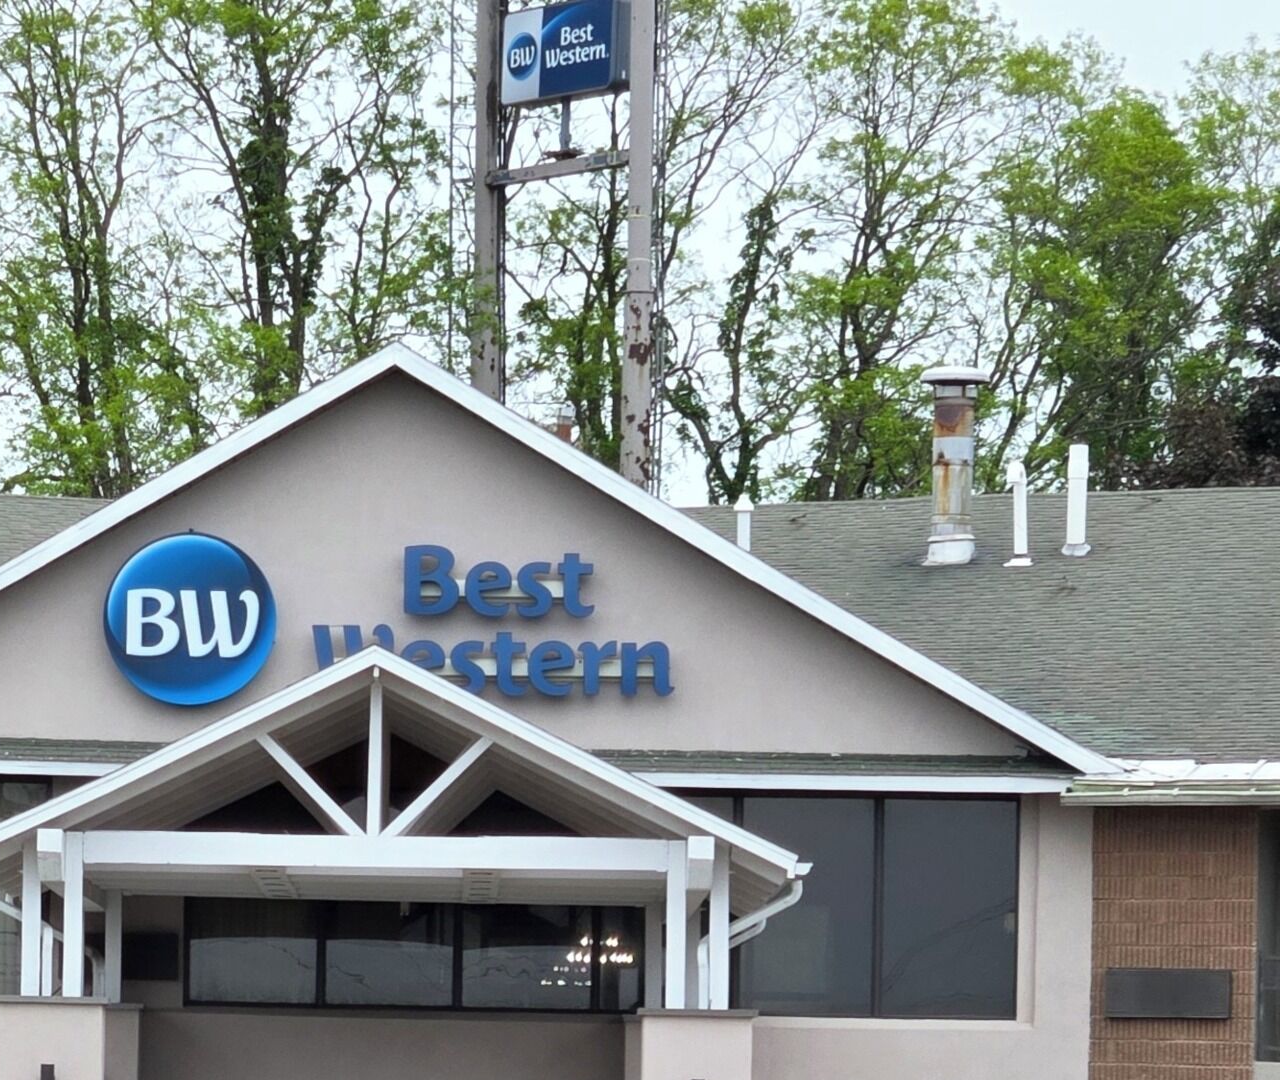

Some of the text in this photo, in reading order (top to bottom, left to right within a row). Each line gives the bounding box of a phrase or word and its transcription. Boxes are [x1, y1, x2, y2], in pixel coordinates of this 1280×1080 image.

[510, 46, 535, 68] BW
[560, 24, 594, 46] Best
[403, 544, 595, 619] Best
[125, 588, 260, 659] BW
